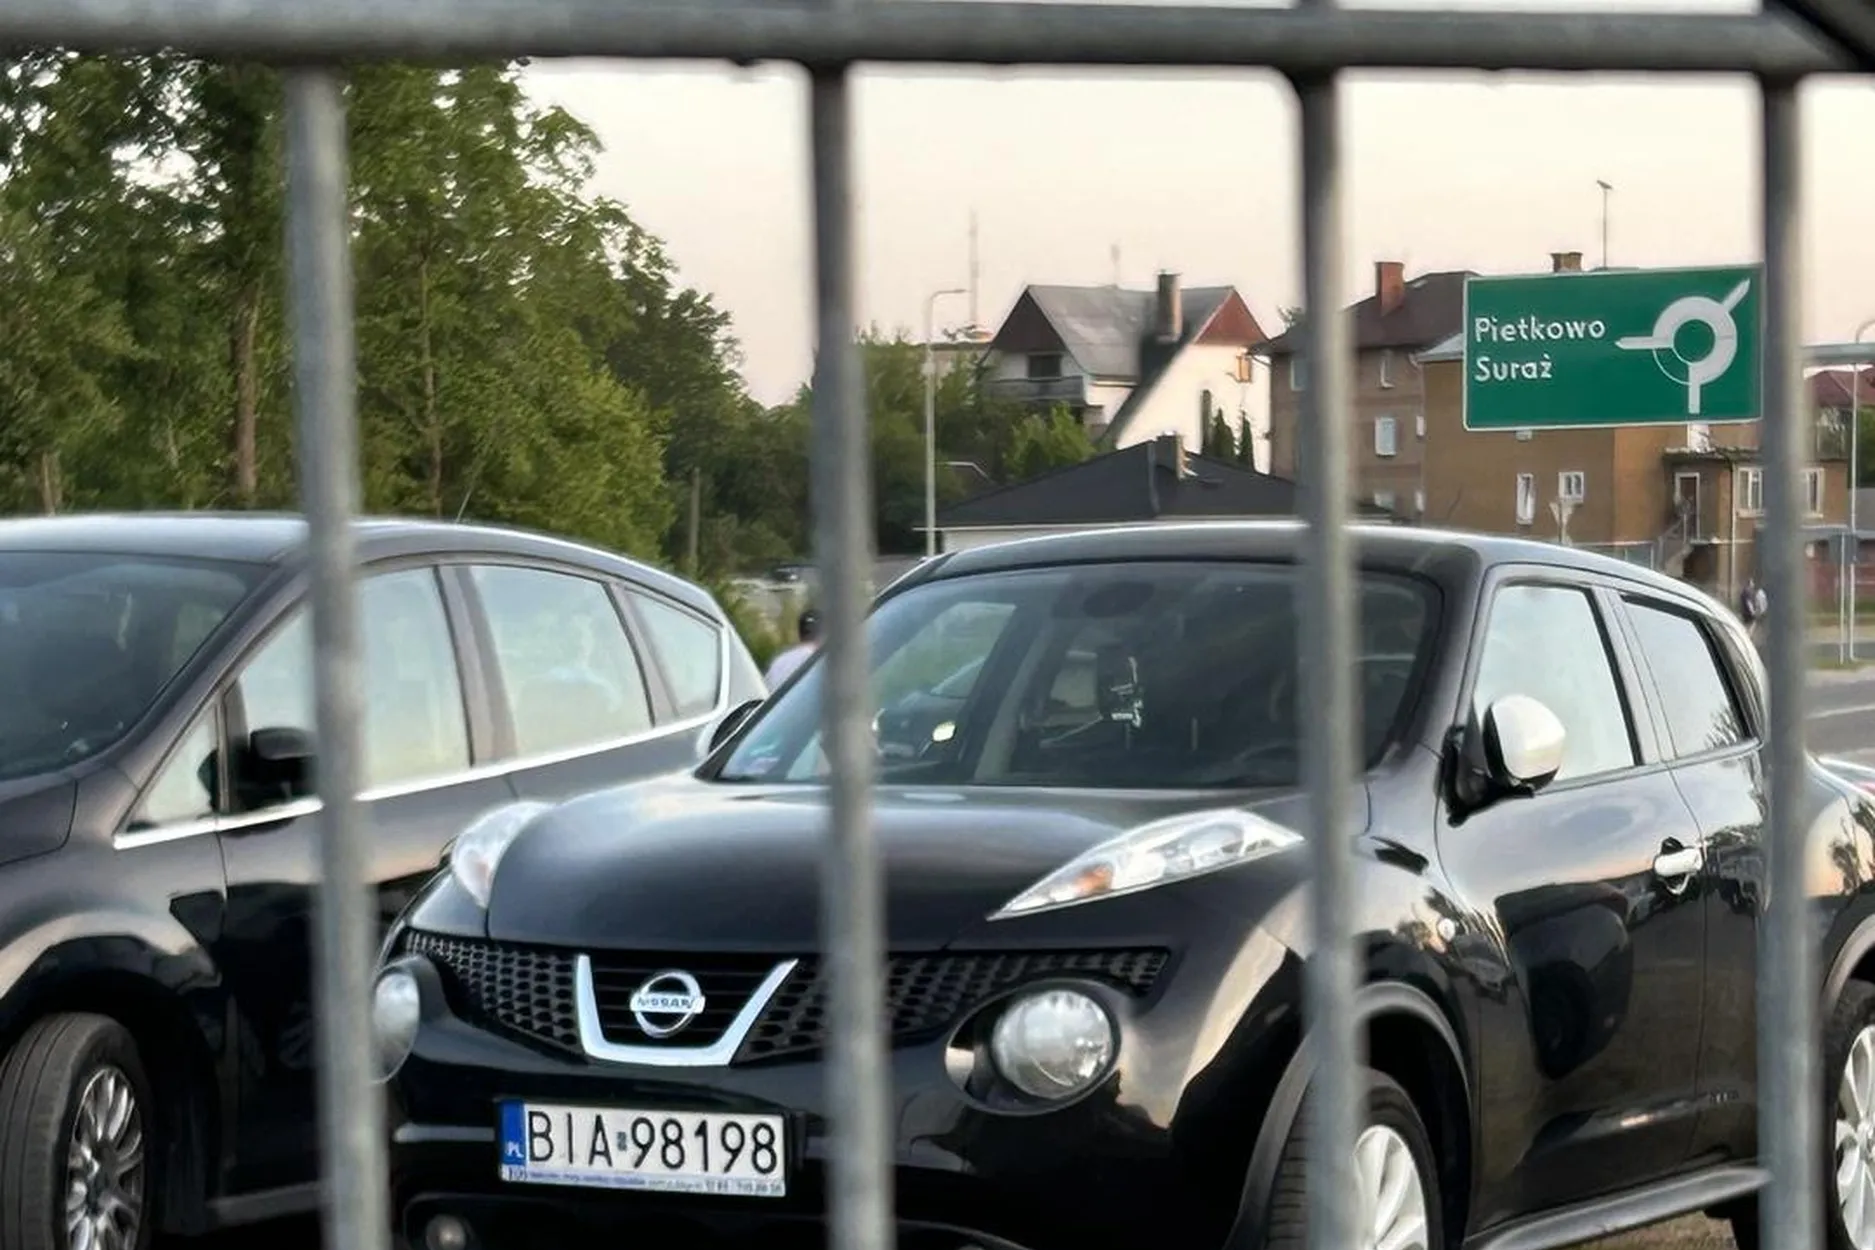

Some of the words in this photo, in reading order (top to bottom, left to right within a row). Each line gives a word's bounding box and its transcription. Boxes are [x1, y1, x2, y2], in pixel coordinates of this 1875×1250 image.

[1474, 316, 1606, 343] Pietkowo
[1474, 353, 1554, 382] Suraż
[527, 1110, 613, 1167] BIA
[630, 1116, 778, 1175] 98198
